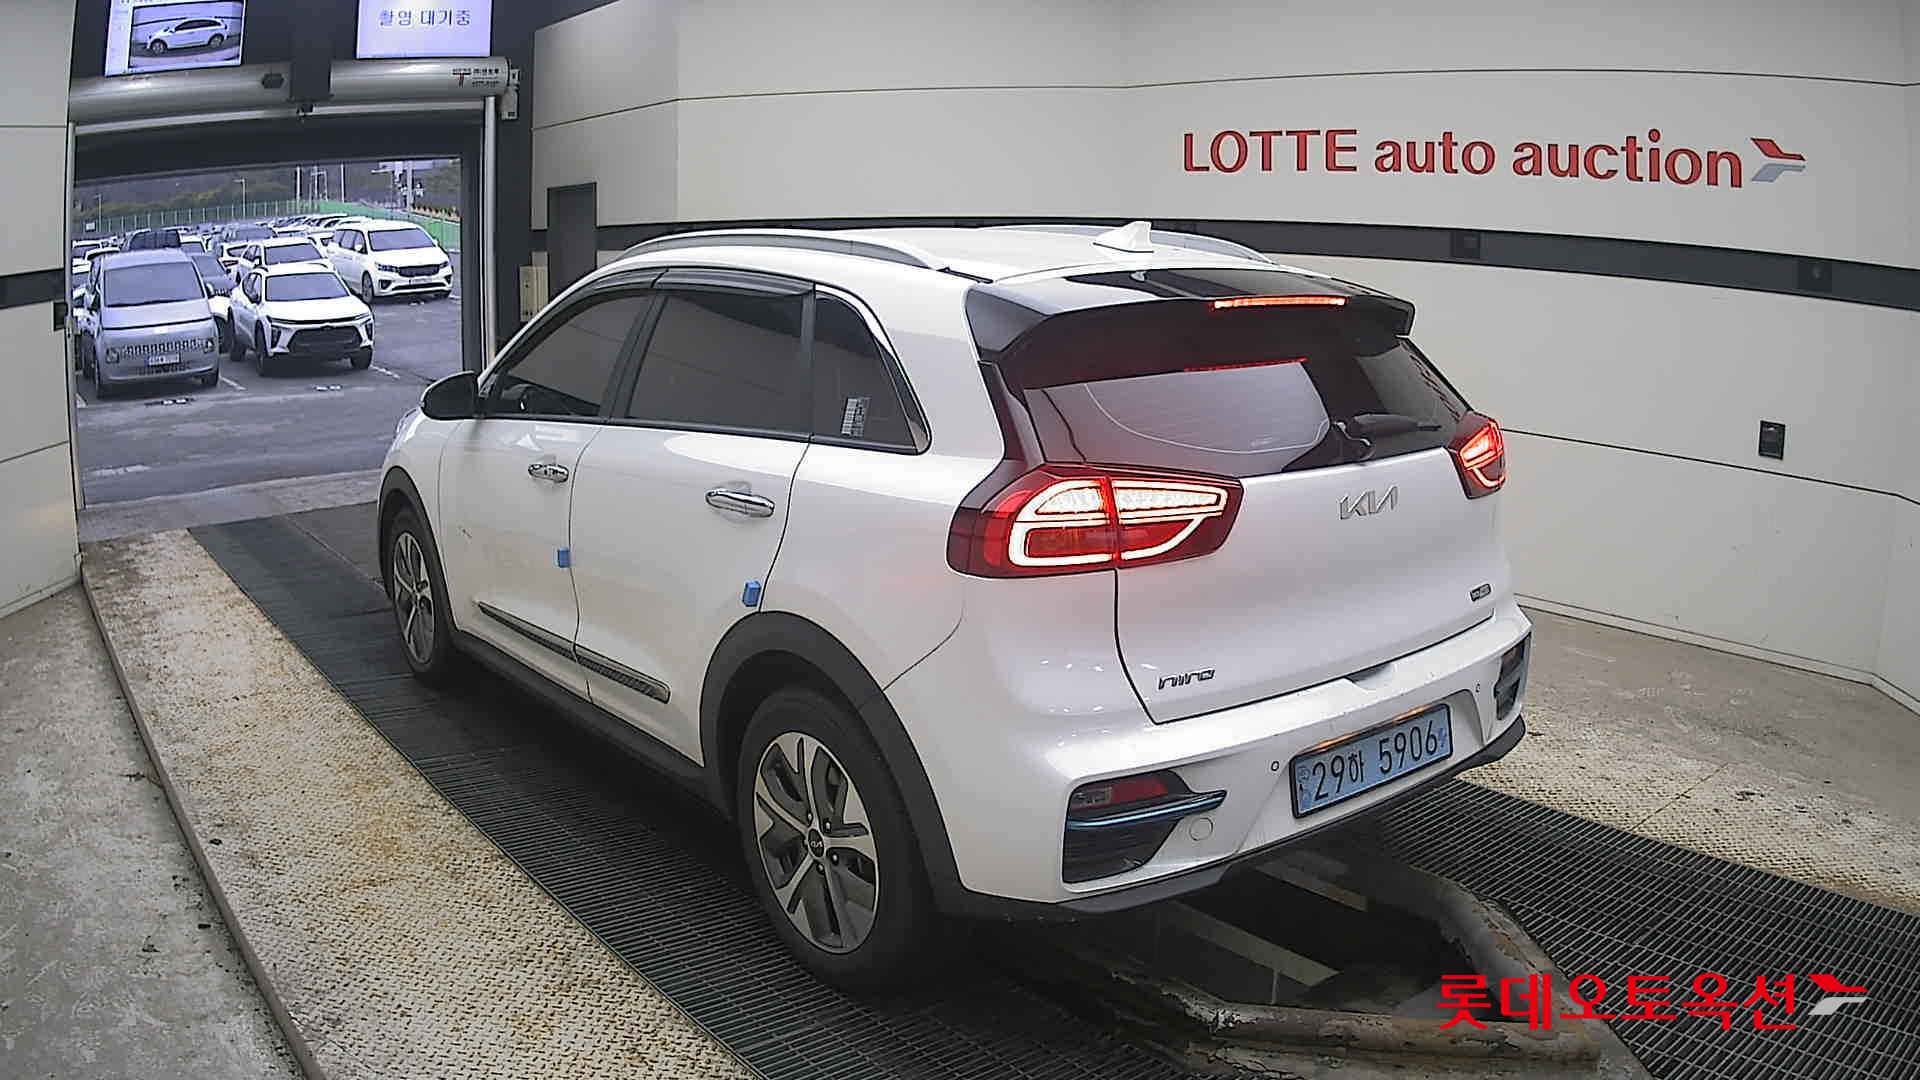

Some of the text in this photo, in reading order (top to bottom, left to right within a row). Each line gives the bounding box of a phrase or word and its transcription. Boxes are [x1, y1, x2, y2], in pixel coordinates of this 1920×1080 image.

[1184, 128, 1742, 188] LOTTE auto auction
[1339, 485, 1398, 520] KIA
[1312, 719, 1438, 801] 29하 5906
